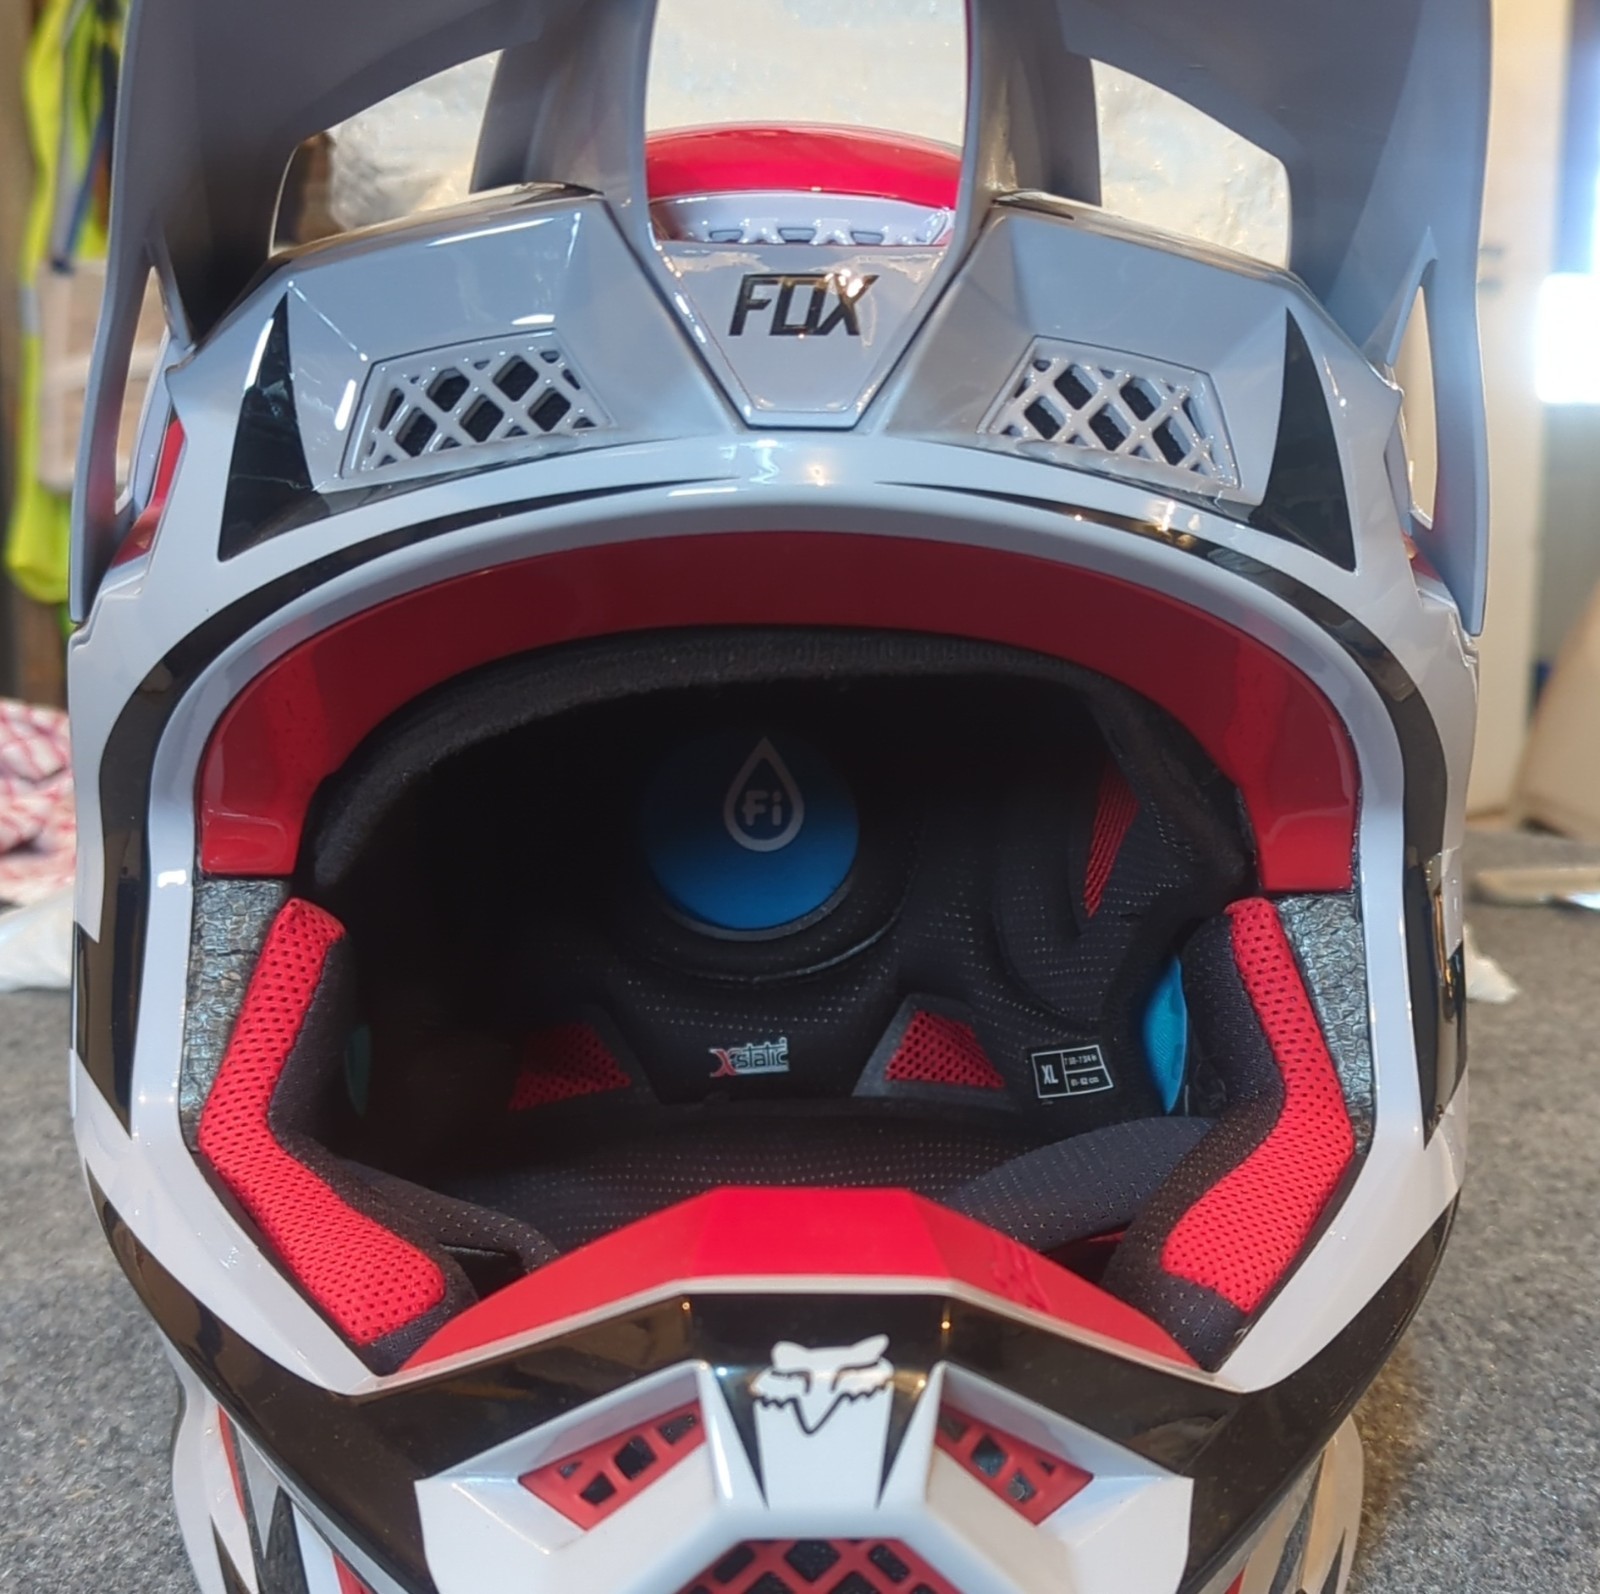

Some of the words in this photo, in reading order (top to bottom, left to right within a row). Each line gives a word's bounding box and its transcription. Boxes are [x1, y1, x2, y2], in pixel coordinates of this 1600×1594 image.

[728, 273, 880, 337] FOX
[742, 789, 783, 827] Fi
[1041, 1064, 1059, 1085] XL
